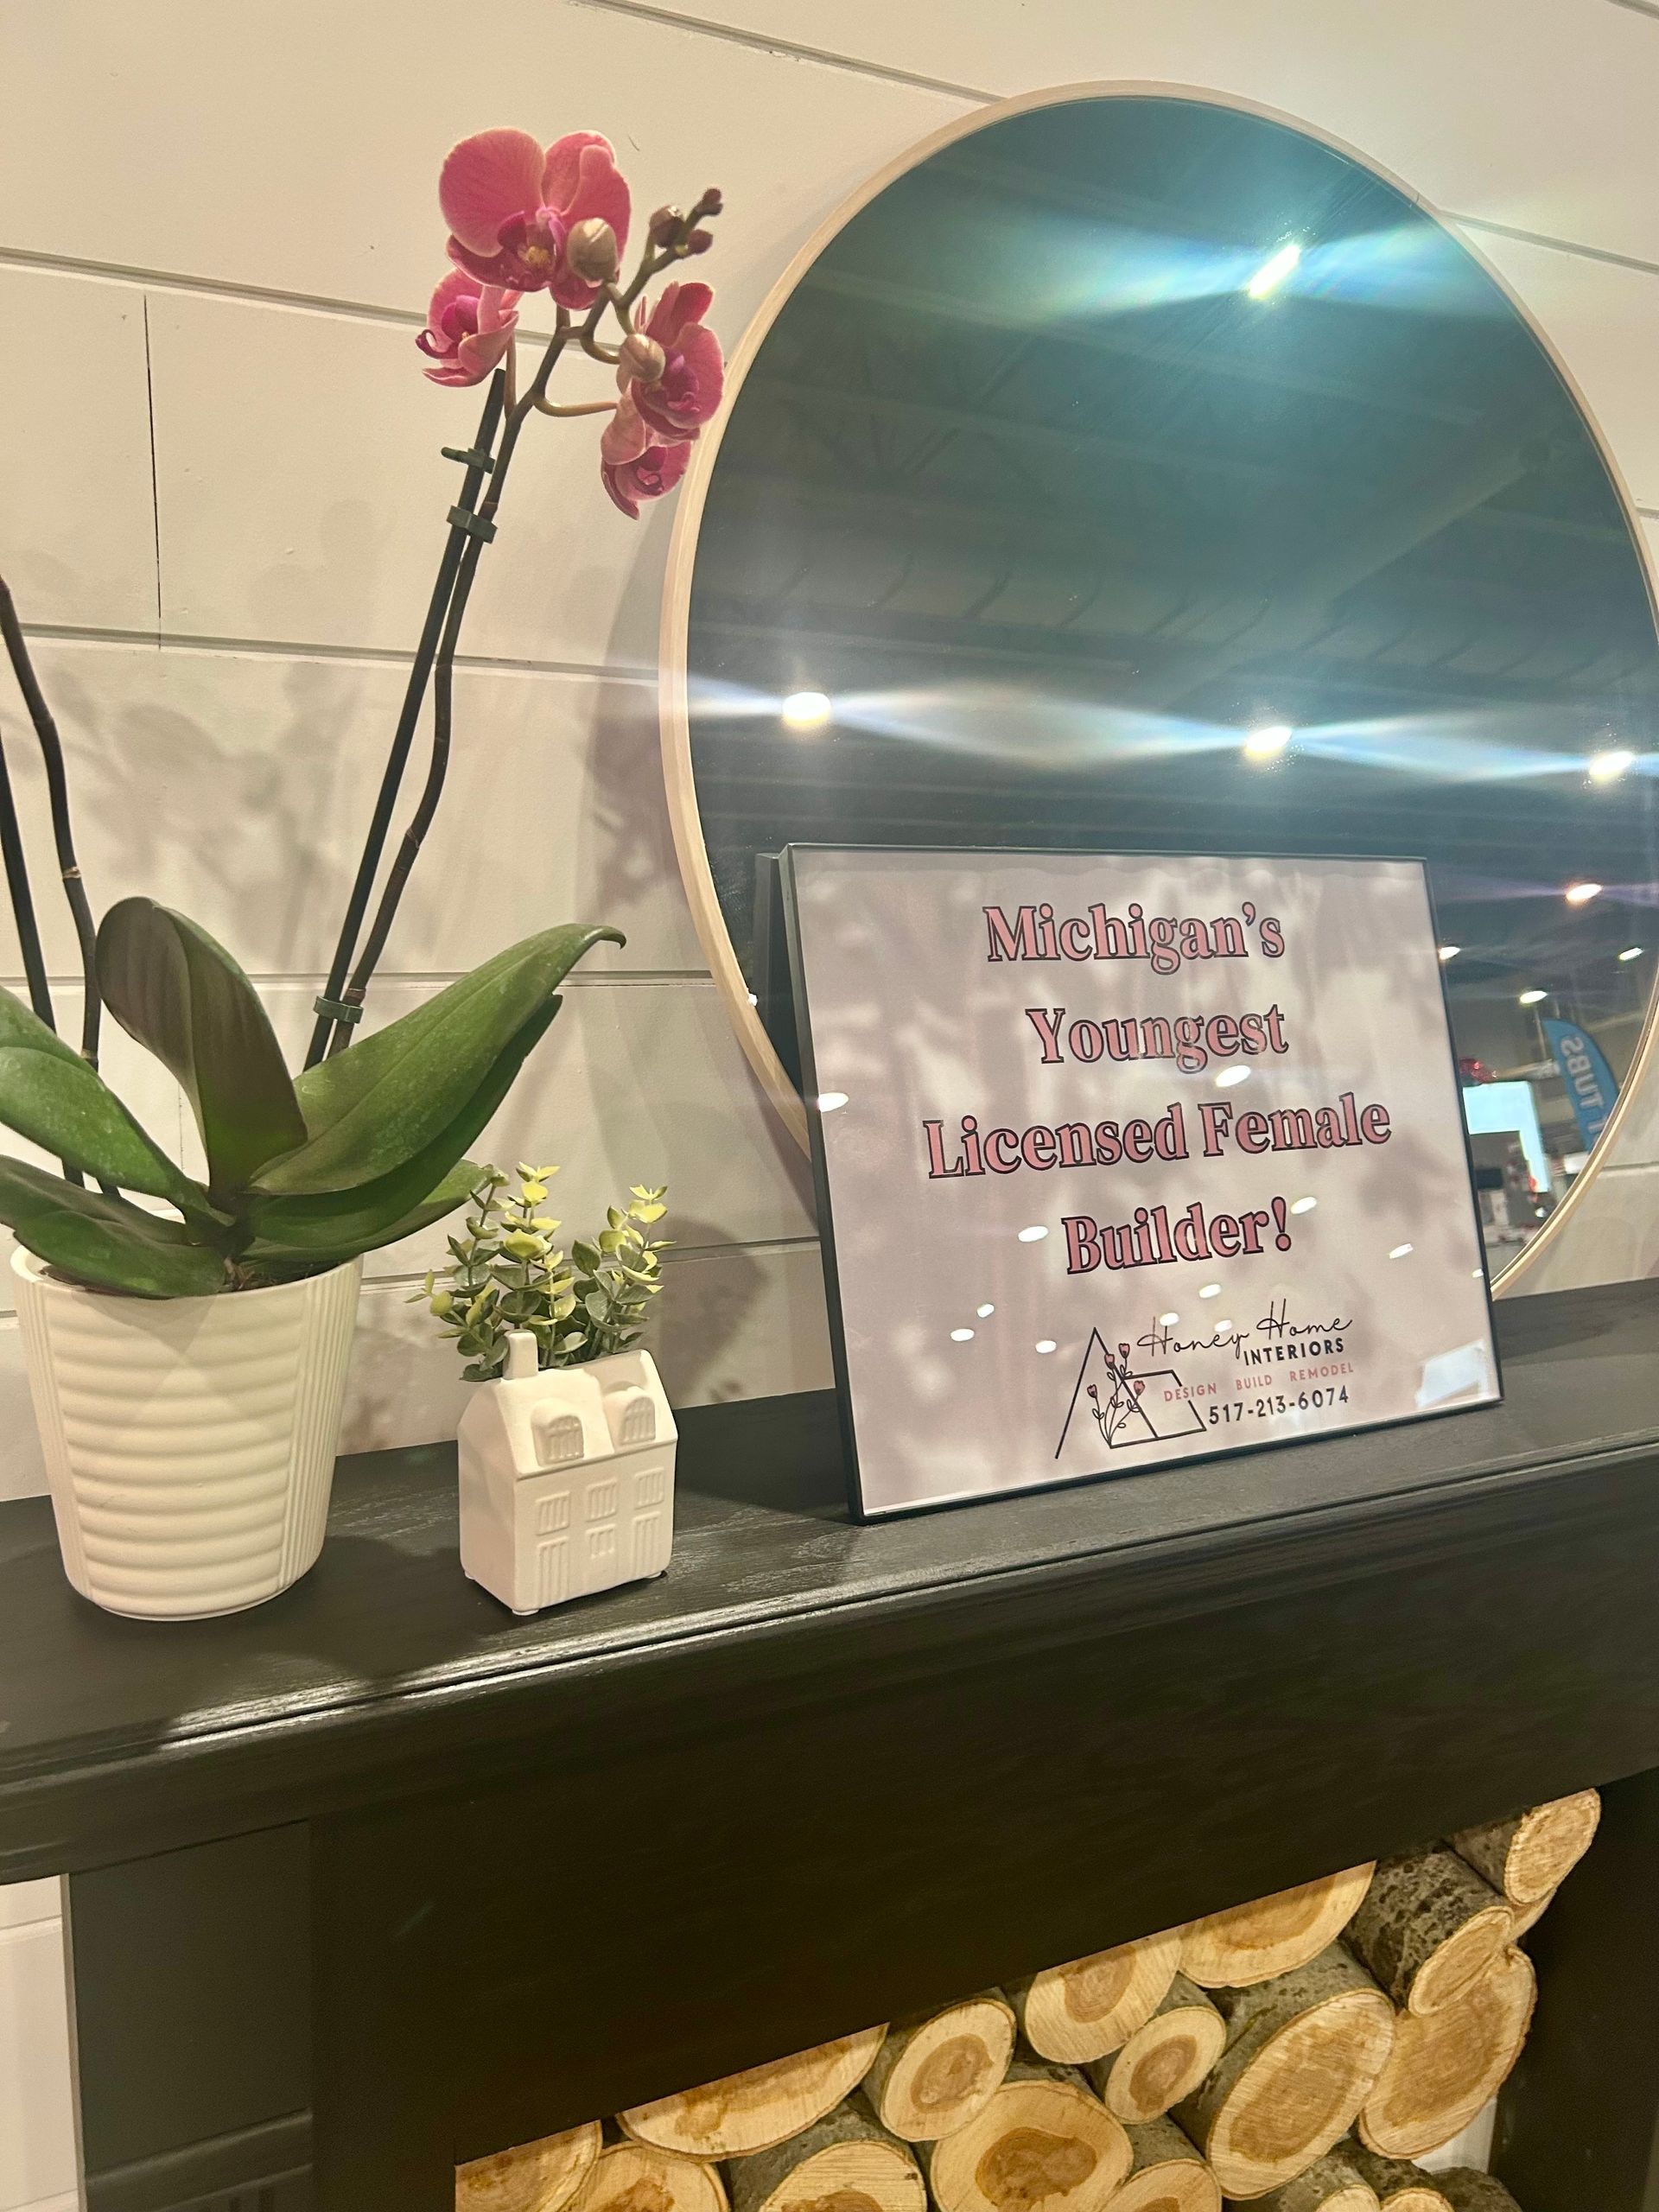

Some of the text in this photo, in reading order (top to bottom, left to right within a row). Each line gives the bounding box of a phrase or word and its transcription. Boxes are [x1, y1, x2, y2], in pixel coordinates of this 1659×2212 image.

[983, 902, 1285, 976] Michigan's
[1026, 1004, 1289, 1074] Youngest
[923, 1092, 1391, 1179] Licensed Female
[1061, 1196, 1293, 1274] Builder!
[1137, 1298, 1353, 1360] Honey Home
[1243, 1337, 1344, 1367] INTERIORS
[1163, 1362, 1355, 1402] DESIGN BUILD REMODEL
[1208, 1384, 1350, 1426] 517-213-6074
